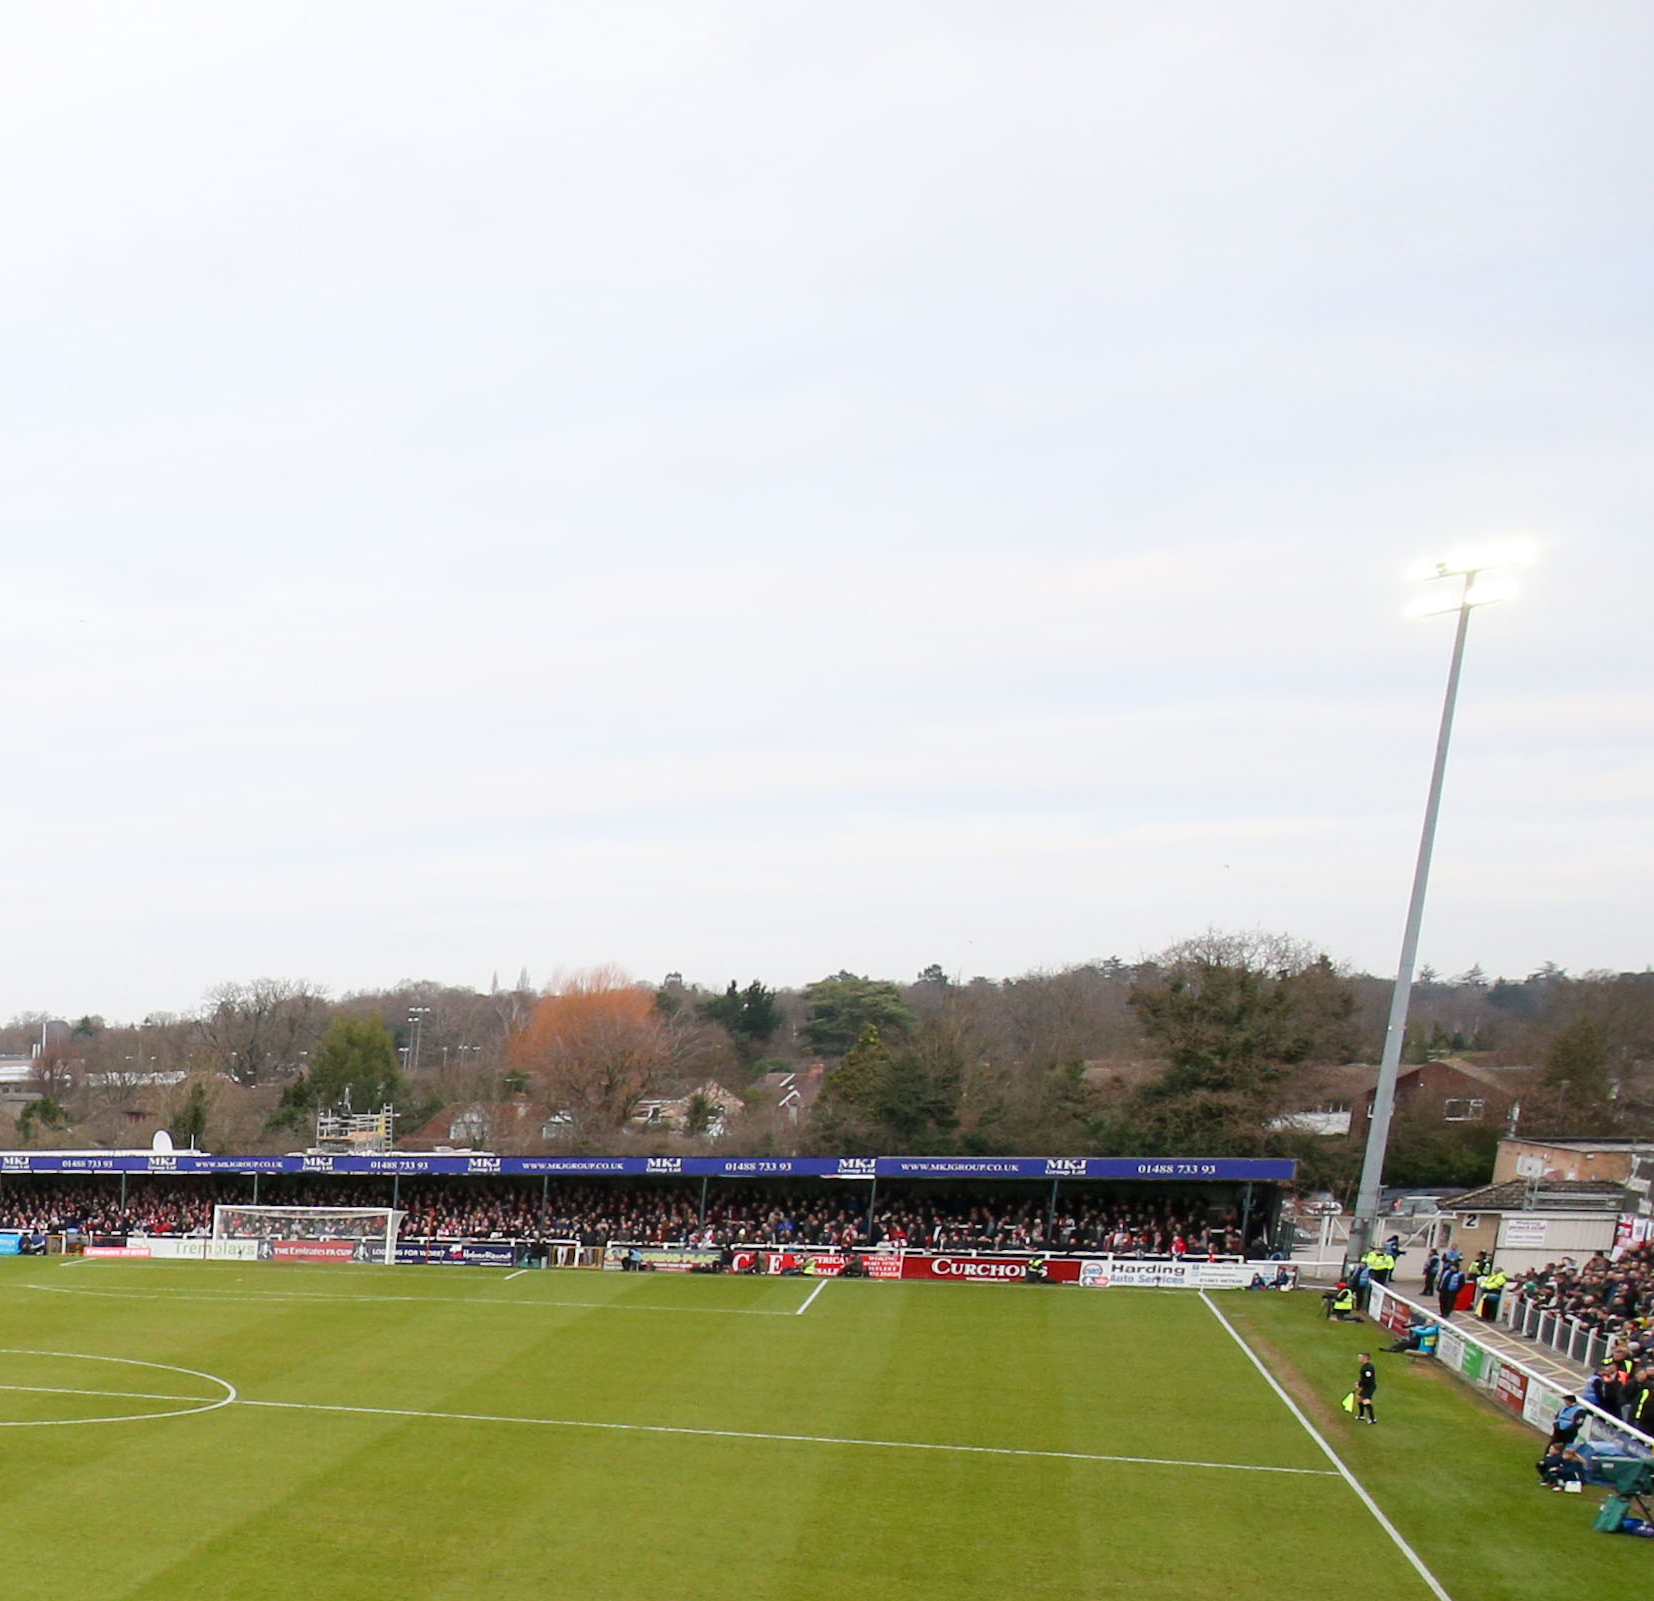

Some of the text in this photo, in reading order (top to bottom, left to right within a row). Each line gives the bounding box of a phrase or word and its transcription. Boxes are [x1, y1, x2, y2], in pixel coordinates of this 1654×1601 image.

[3, 1157, 29, 1165] MKJ
[149, 1157, 177, 1165] MKJ
[303, 1157, 333, 1166] MKJ
[371, 1161, 429, 1170] 01488 733 93
[469, 1158, 501, 1167] MKJ
[647, 1158, 681, 1168] MKJ
[839, 1158, 877, 1168] MKJ
[1046, 1160, 1087, 1169] MKJ
[522, 1162, 624, 1170] WWW.MKJGROUP.CO.UK
[725, 1162, 792, 1171] 01488 733 93
[901, 1163, 1019, 1172] WWW.MKJGROUP.CO.UK
[1138, 1165, 1216, 1174] 01488 733 93
[1466, 1214, 1475, 1226] 2
[1111, 1264, 1185, 1276] Harding
